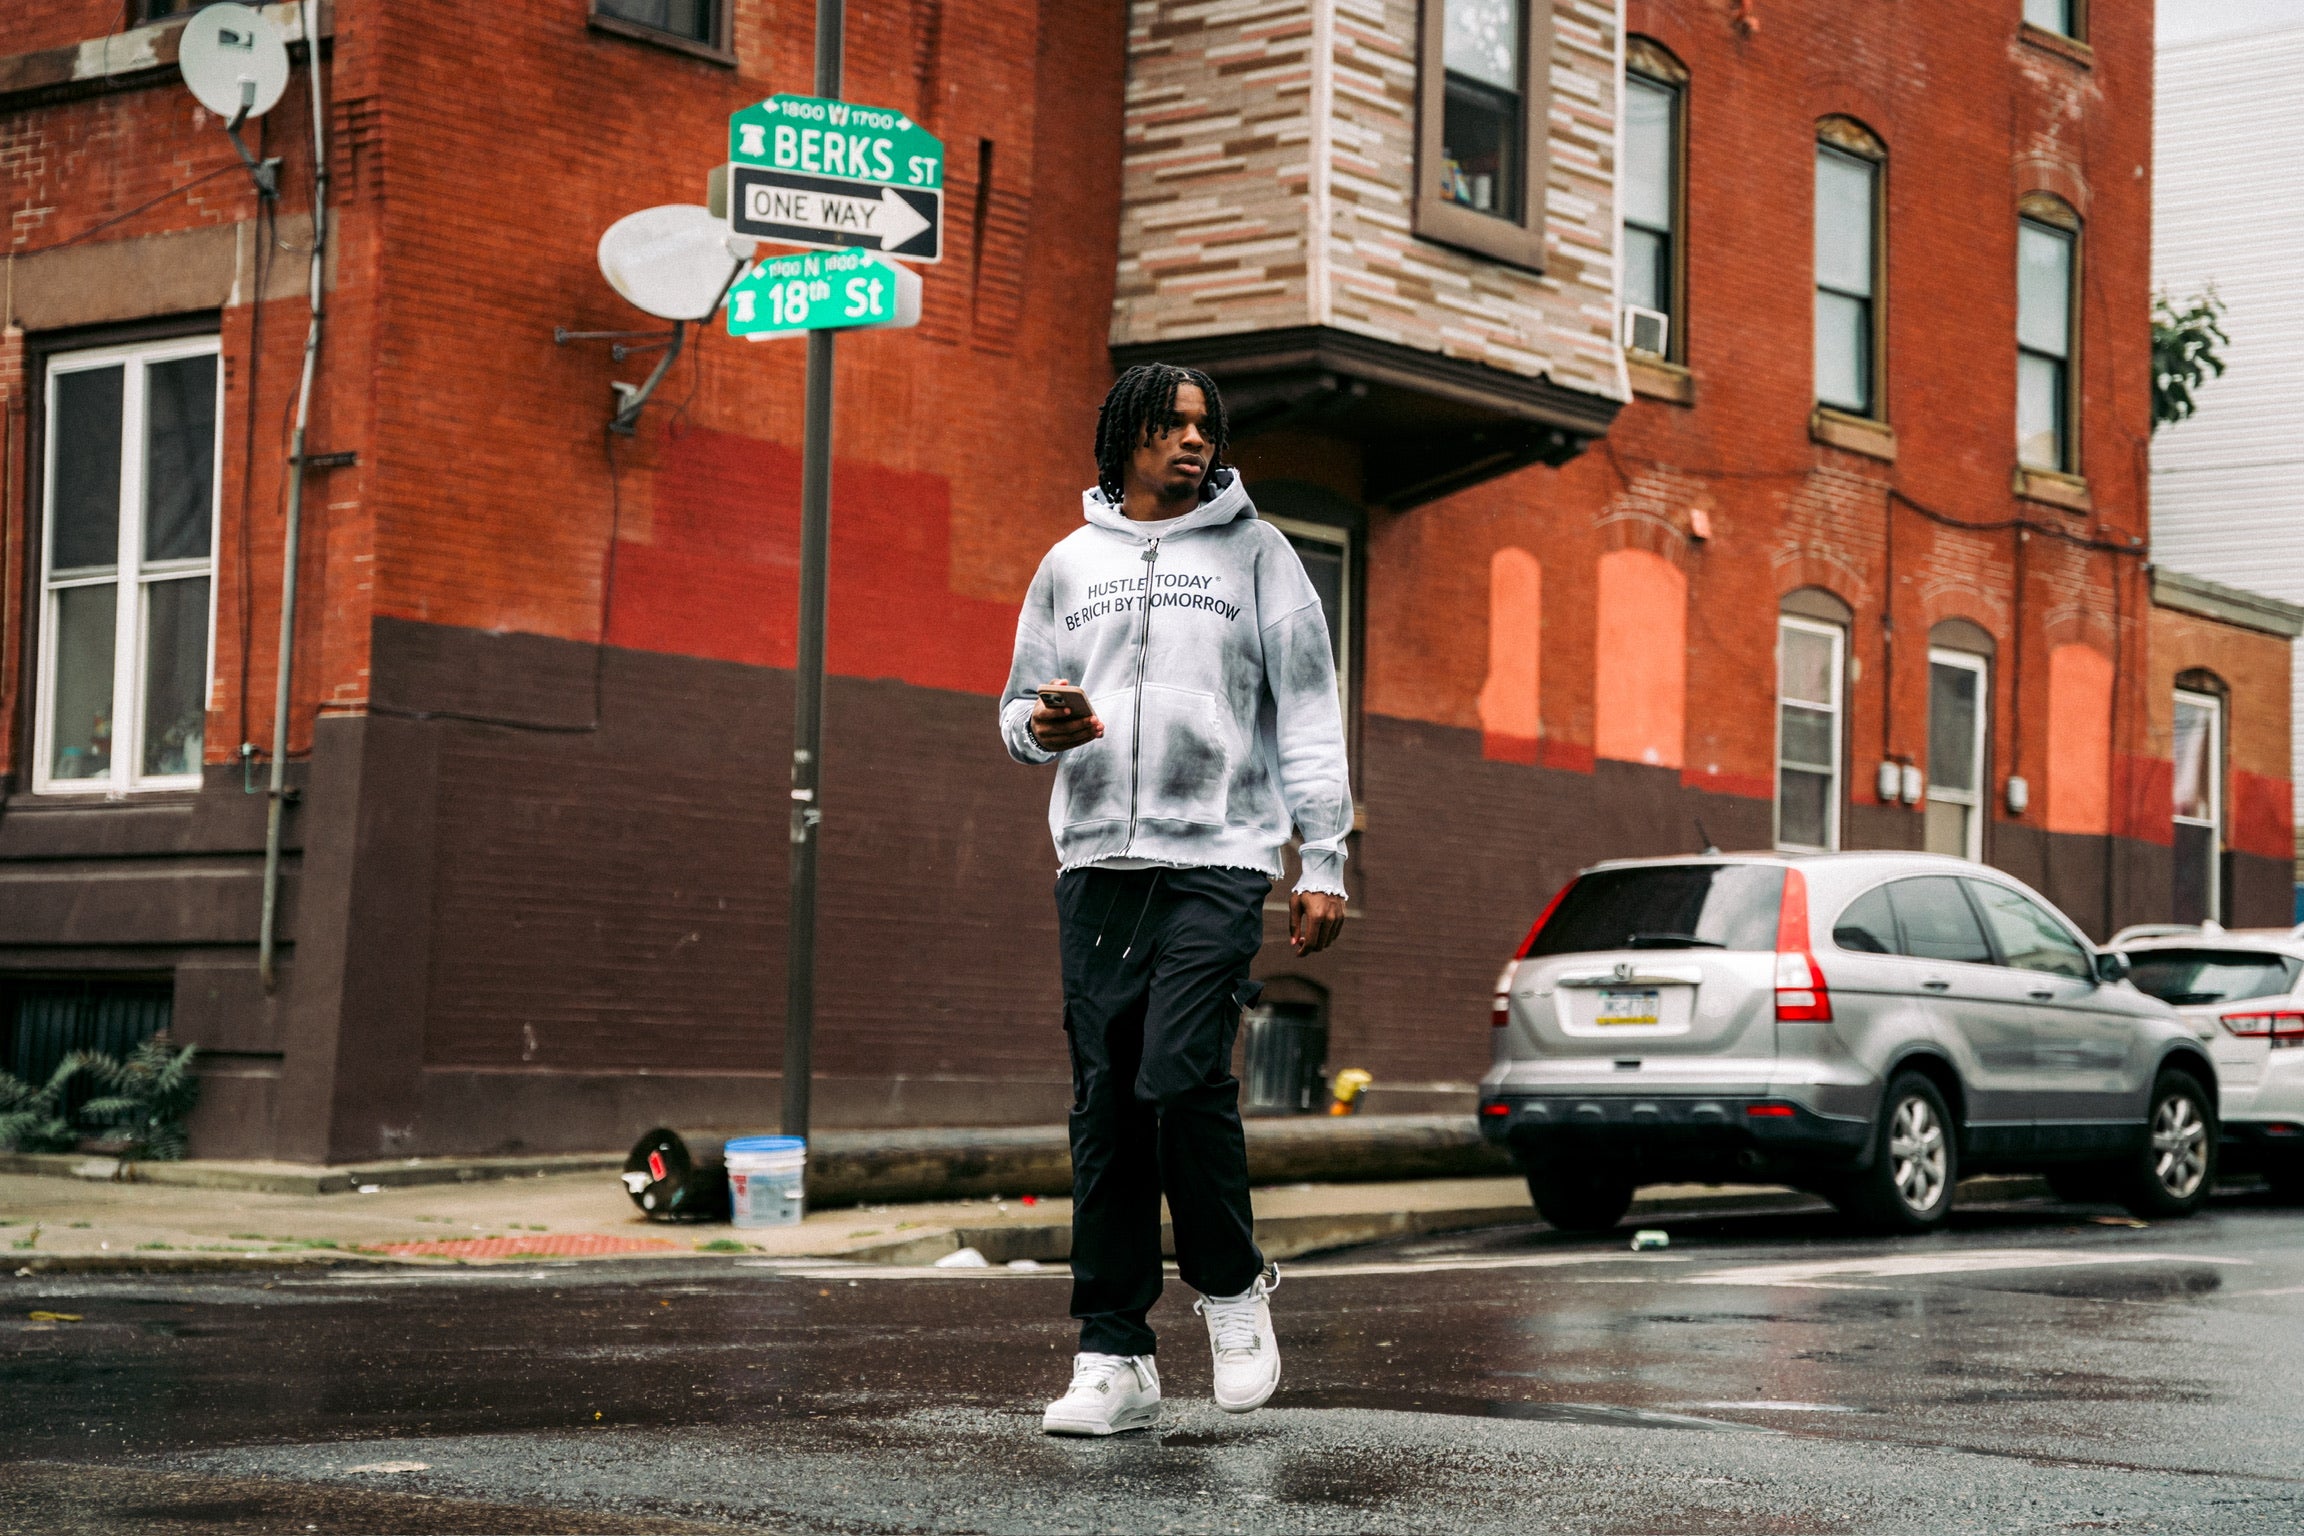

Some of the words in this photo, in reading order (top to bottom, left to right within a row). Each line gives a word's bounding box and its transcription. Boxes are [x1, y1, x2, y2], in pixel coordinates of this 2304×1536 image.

[781, 100, 825, 121] 1800
[828, 103, 850, 127] W
[851, 110, 894, 130] 1700
[774, 124, 895, 181] BERKS
[908, 155, 938, 185] ST
[754, 190, 808, 222] ONE
[821, 198, 876, 229] WAY
[804, 256, 820, 278] N
[768, 279, 831, 325] 18th
[844, 277, 884, 318] St
[1088, 577, 1148, 600] HUSTLE
[1065, 612, 1082, 631] BE
[1082, 599, 1110, 624] RICH
[1115, 597, 1134, 612] BY
[1137, 592, 1241, 622] TOMORROW
